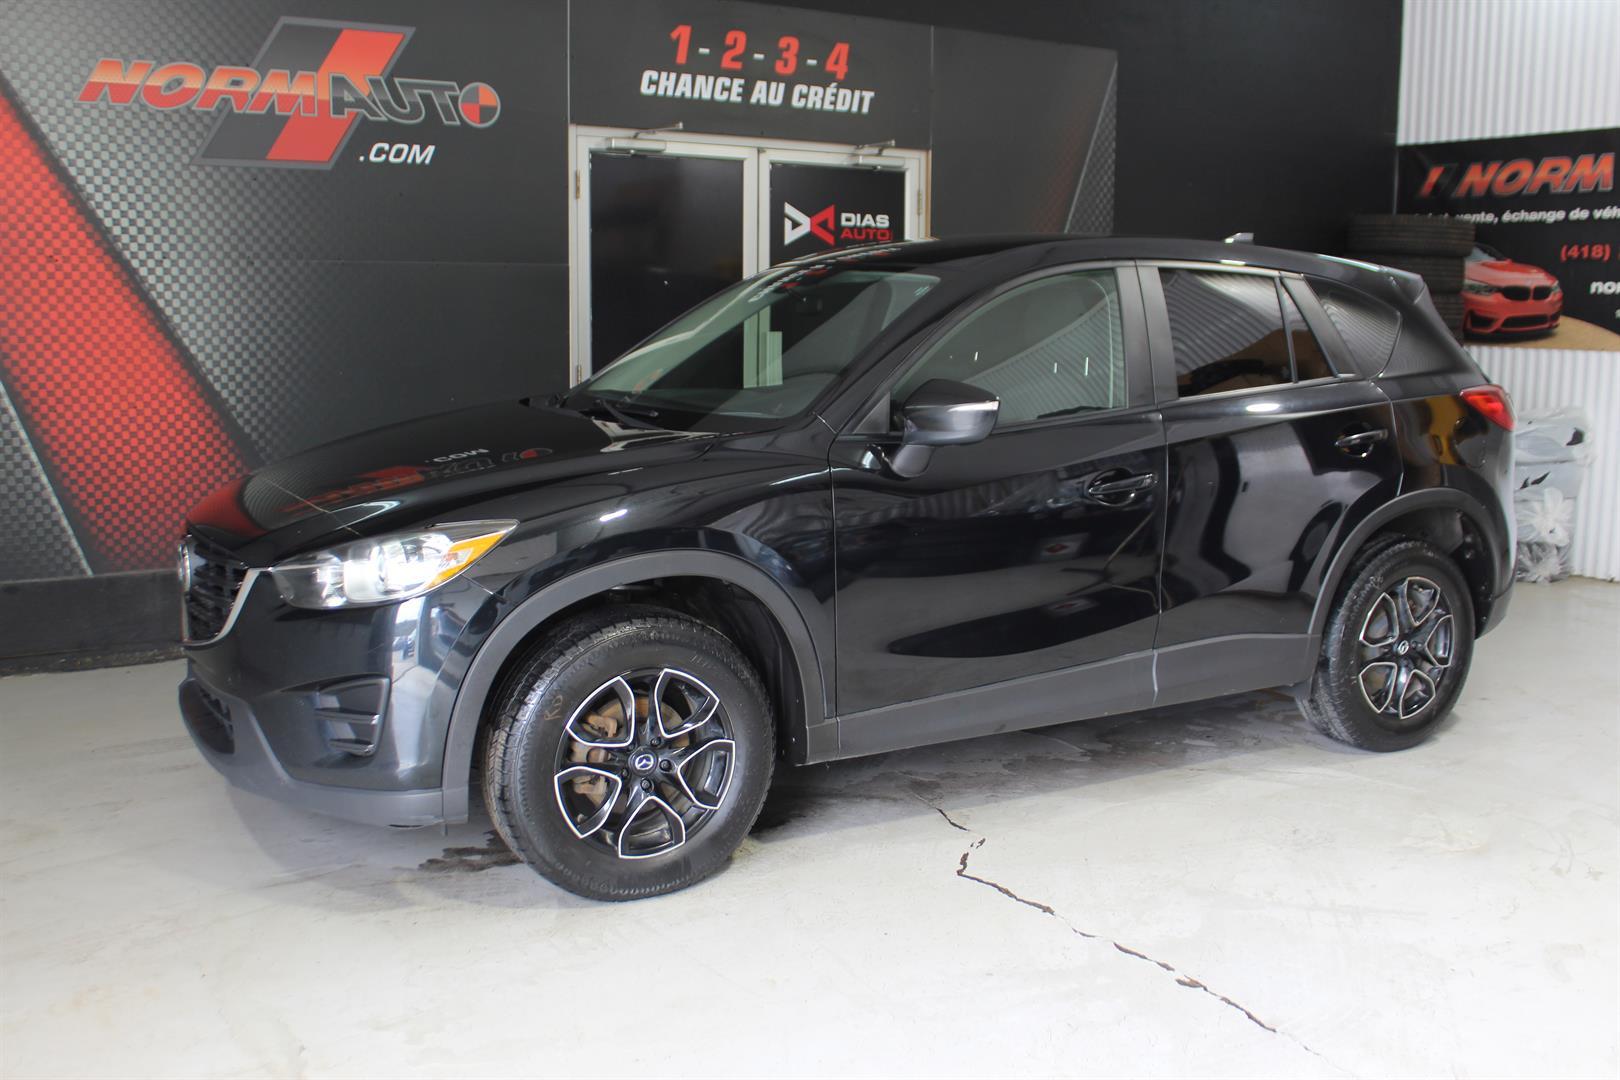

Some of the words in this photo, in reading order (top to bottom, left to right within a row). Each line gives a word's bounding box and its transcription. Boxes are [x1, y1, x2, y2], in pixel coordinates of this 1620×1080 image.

[640, 69, 744, 103] CHANCE
[750, 80, 785, 107] AU
[791, 83, 875, 114] CRÉDIT
[358, 142, 436, 165] .COM
[1455, 153, 1615, 197] NORM
[841, 212, 890, 228] DIAS
[1501, 209, 1566, 223] échange
[1568, 207, 1590, 221] de
[841, 228, 891, 240] AUTO
[1560, 244, 1611, 262] (418)
